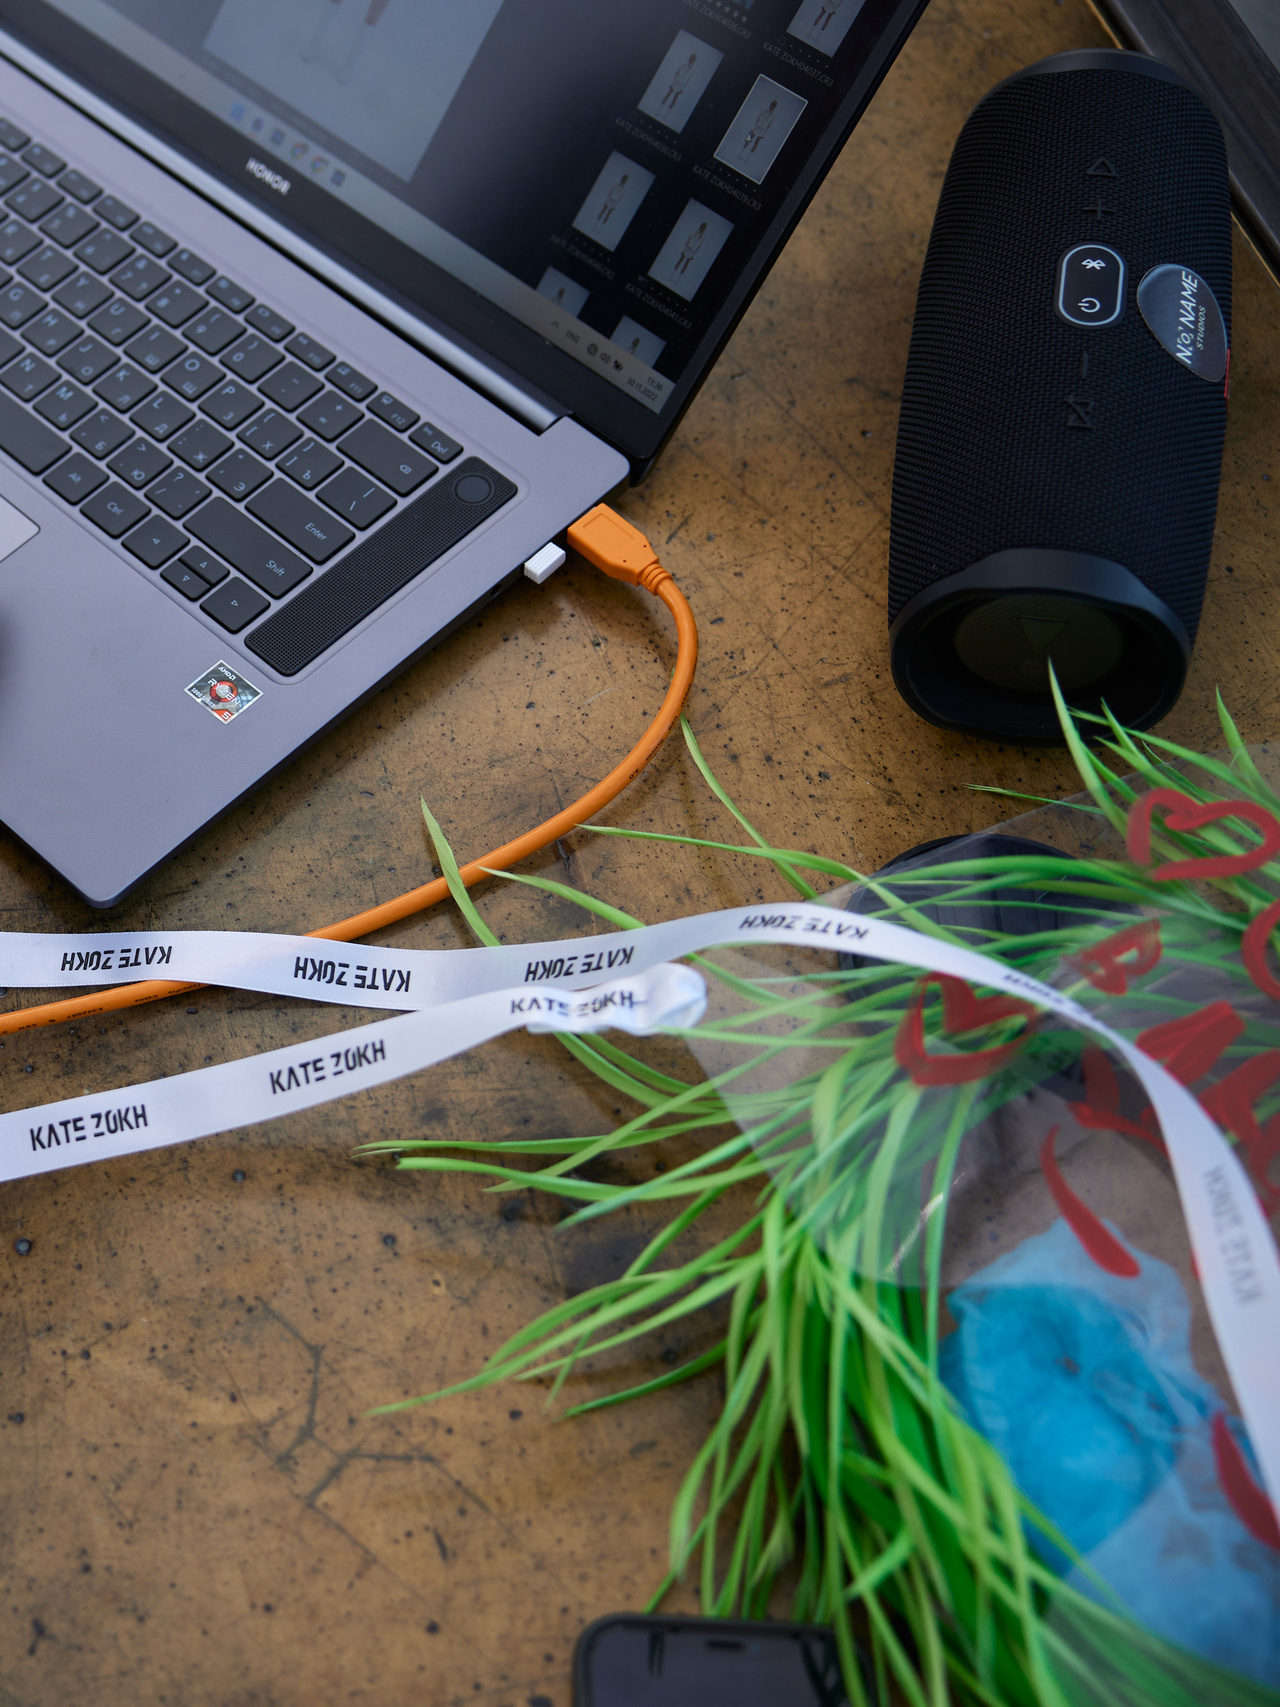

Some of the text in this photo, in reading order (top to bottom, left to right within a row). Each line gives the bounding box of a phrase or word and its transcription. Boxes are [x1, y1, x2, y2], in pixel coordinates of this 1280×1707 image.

[762, 41, 835, 88] KATE ZOKH04037.CR3
[615, 117, 633, 133] KATE
[245, 156, 291, 196] HONOR
[692, 164, 763, 212] KATE ZOKH04039.CR3
[625, 282, 643, 299] KATE
[1179, 270, 1198, 329] NAME
[1196, 305, 1206, 350] STUDIOS
[431, 440, 449, 454] Del
[68, 472, 82, 484] Alt
[106, 502, 124, 515] Ctrl
[304, 522, 328, 541] Enter
[265, 560, 286, 577] Shift
[218, 666, 235, 680] AMD
[208, 678, 241, 706] RYZEN
[221, 711, 231, 720] 5
[803, 917, 870, 940] KATE
[61, 946, 173, 972] KATE ZOKH
[525, 946, 635, 983] KATE ZOKH
[293, 956, 411, 993] KATE ZOKH
[511, 991, 635, 1017] KATE ZOKH
[18, 1023, 37, 1031] AWM
[269, 1040, 386, 1095] KATE ZOKH
[29, 1104, 148, 1152] KATE ZOKH
